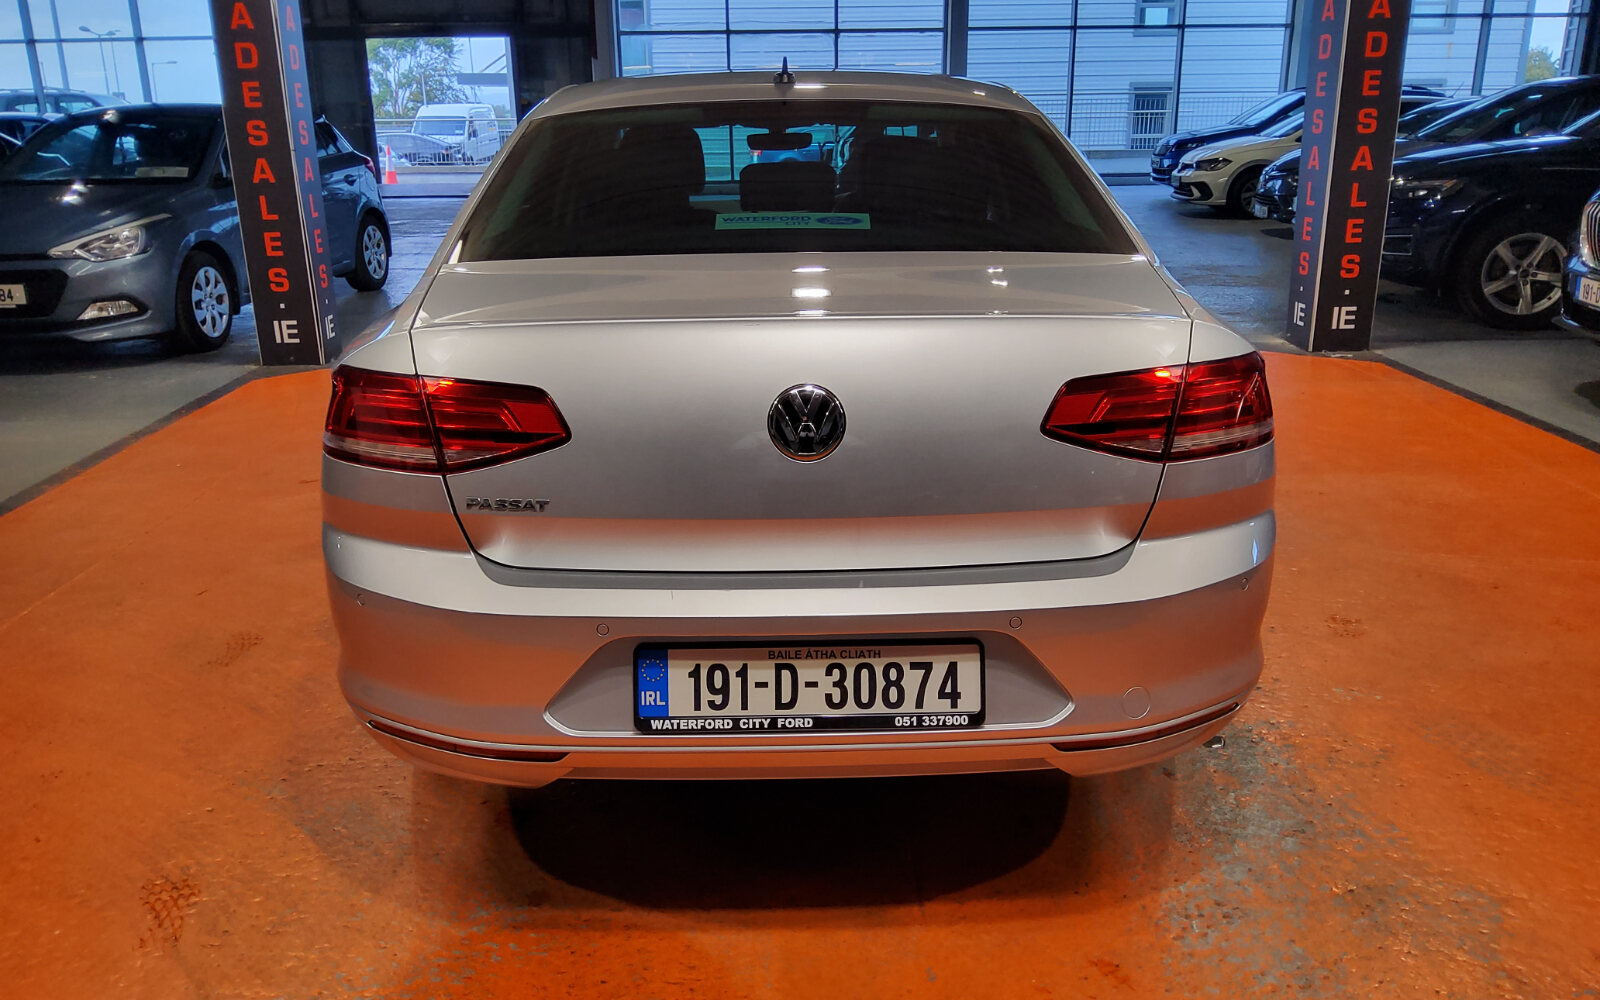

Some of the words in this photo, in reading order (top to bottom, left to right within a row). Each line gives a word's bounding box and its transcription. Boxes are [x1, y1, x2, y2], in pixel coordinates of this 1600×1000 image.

[722, 215, 811, 223] WATERFORD
[465, 496, 550, 512] PASSAT
[768, 650, 802, 660] BAILE
[805, 648, 838, 660] ÁTHA
[840, 649, 881, 659] CLIATH
[688, 661, 962, 711] 191-D-30874
[641, 691, 665, 706] IRL
[650, 719, 733, 730] WATERFORD
[739, 719, 770, 729] CITY
[777, 718, 814, 728] FORD
[895, 716, 918, 727] 051
[922, 715, 969, 726] 337900
